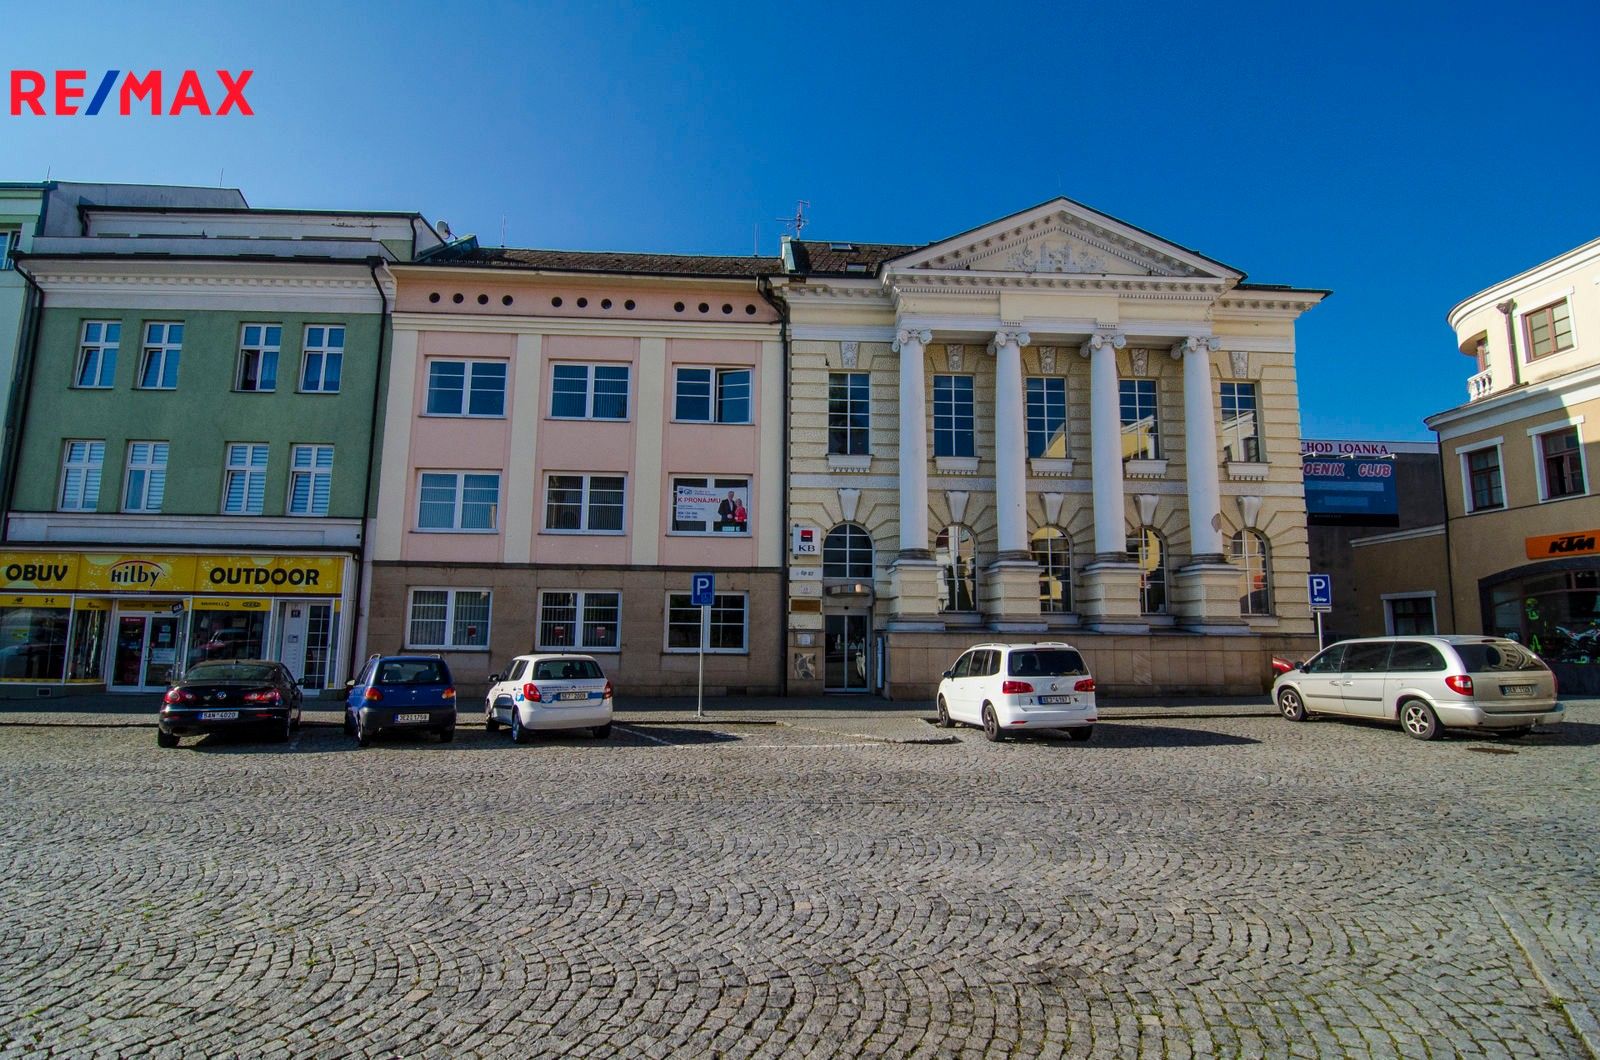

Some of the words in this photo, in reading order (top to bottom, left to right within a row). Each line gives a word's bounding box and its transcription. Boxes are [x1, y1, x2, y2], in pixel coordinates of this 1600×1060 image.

[1339, 443, 1389, 454] LOANKA
[1358, 463, 1392, 477] CLUB
[1549, 535, 1595, 553] KTM
[6, 564, 68, 581] OBUV
[210, 567, 319, 585] OUTDOOR
[697, 578, 709, 595] P
[1313, 579, 1325, 595] P
